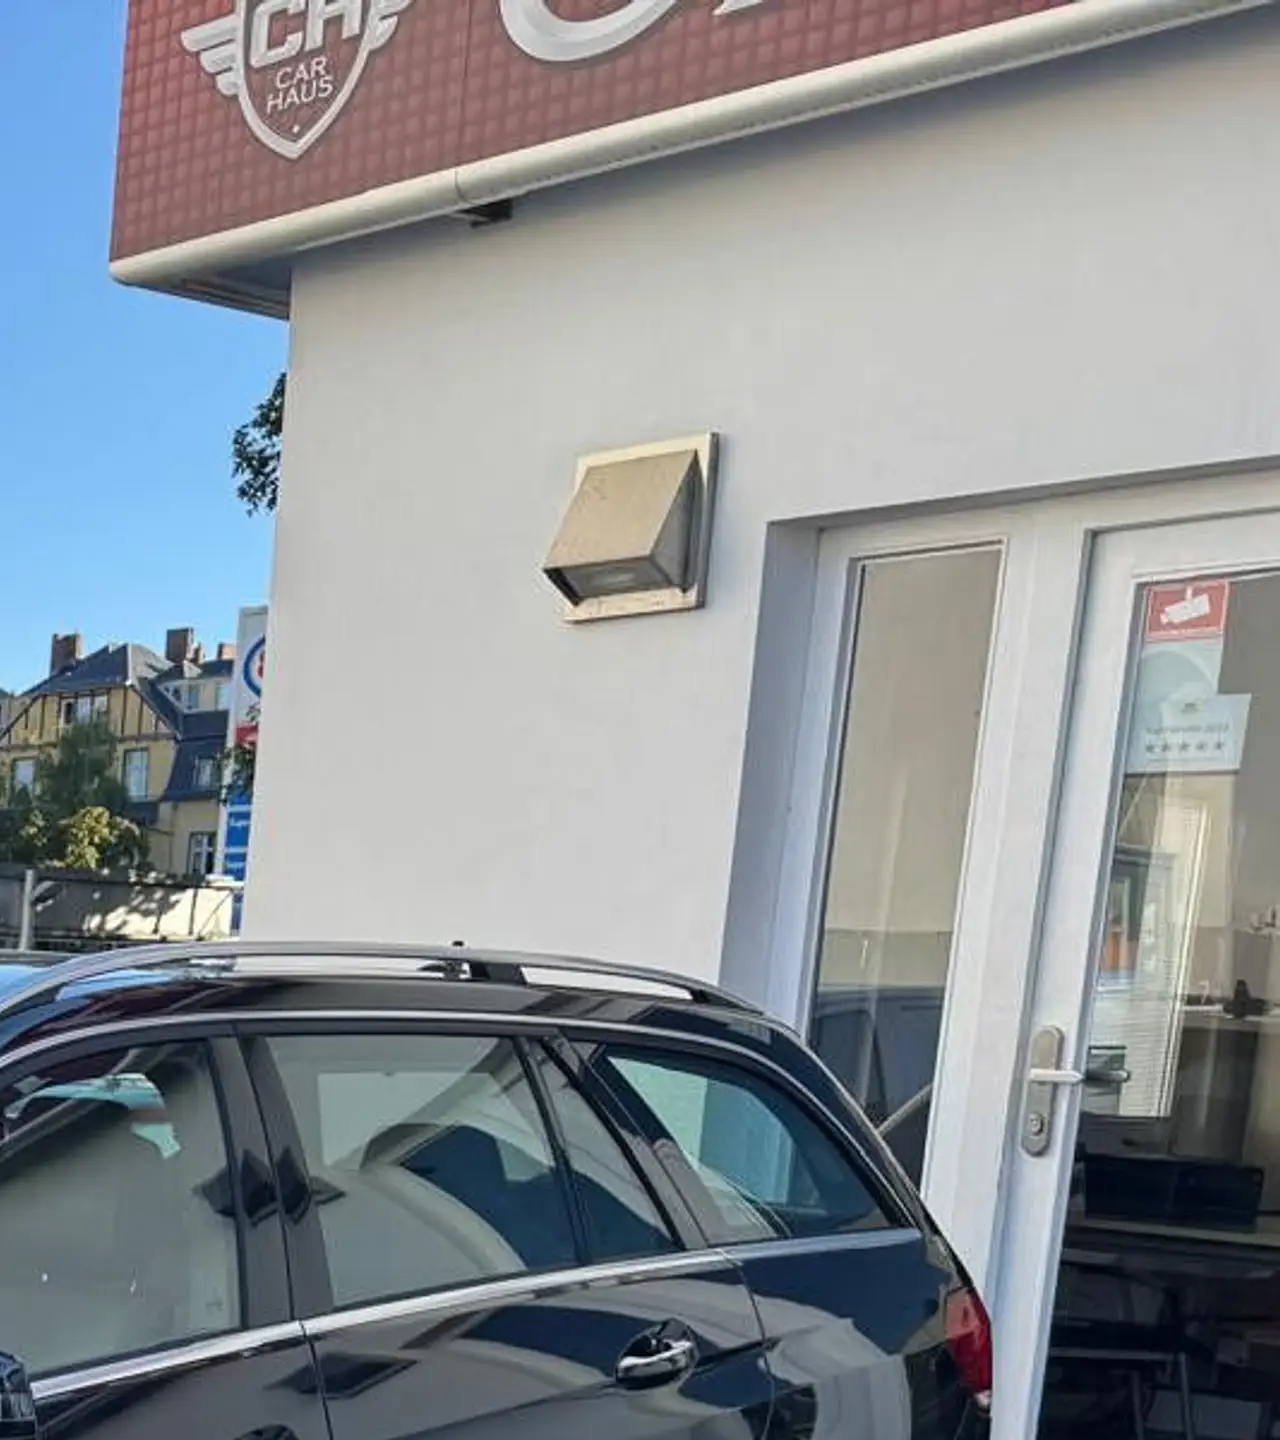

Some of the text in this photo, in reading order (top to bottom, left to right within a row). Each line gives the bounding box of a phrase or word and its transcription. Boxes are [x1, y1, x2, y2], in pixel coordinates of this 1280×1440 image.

[250, 0, 362, 68] CH
[276, 56, 328, 89] CAR
[267, 76, 333, 114] HAUS
